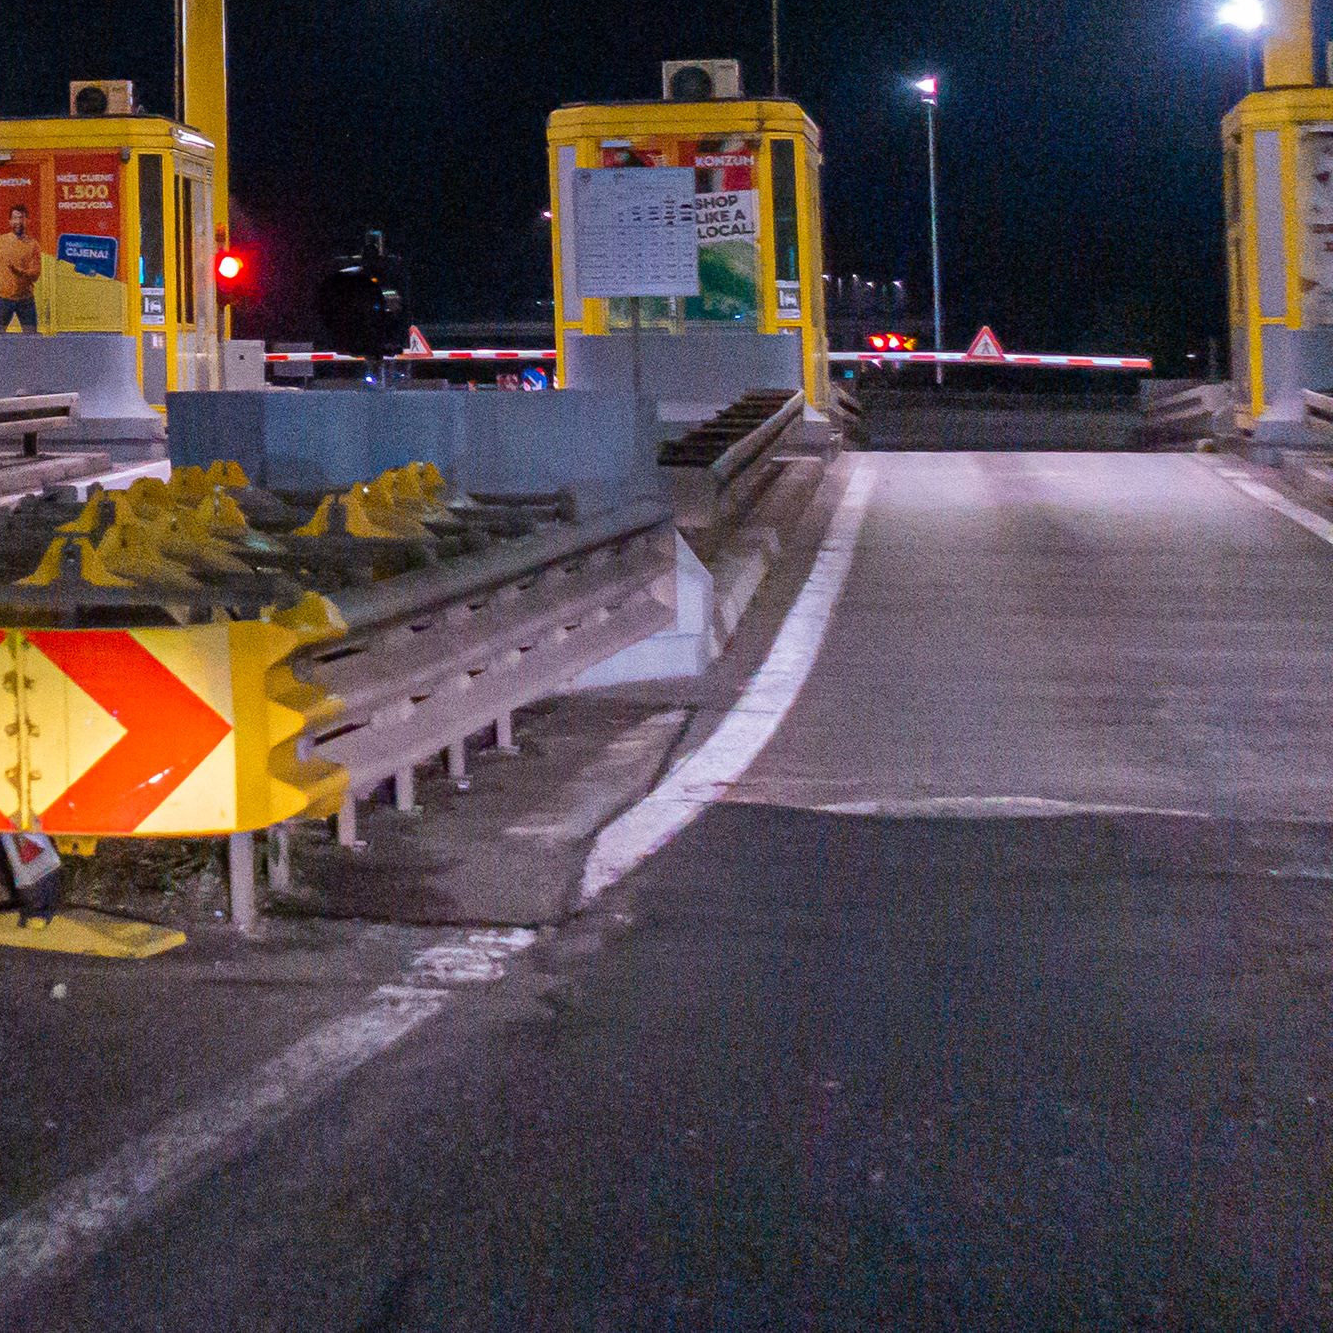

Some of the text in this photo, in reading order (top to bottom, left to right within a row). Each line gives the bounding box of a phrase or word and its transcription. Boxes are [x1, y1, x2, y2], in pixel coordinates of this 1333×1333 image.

[695, 155, 754, 166] KONZUM
[695, 195, 738, 210] SHOP
[695, 209, 746, 224] LIKE A
